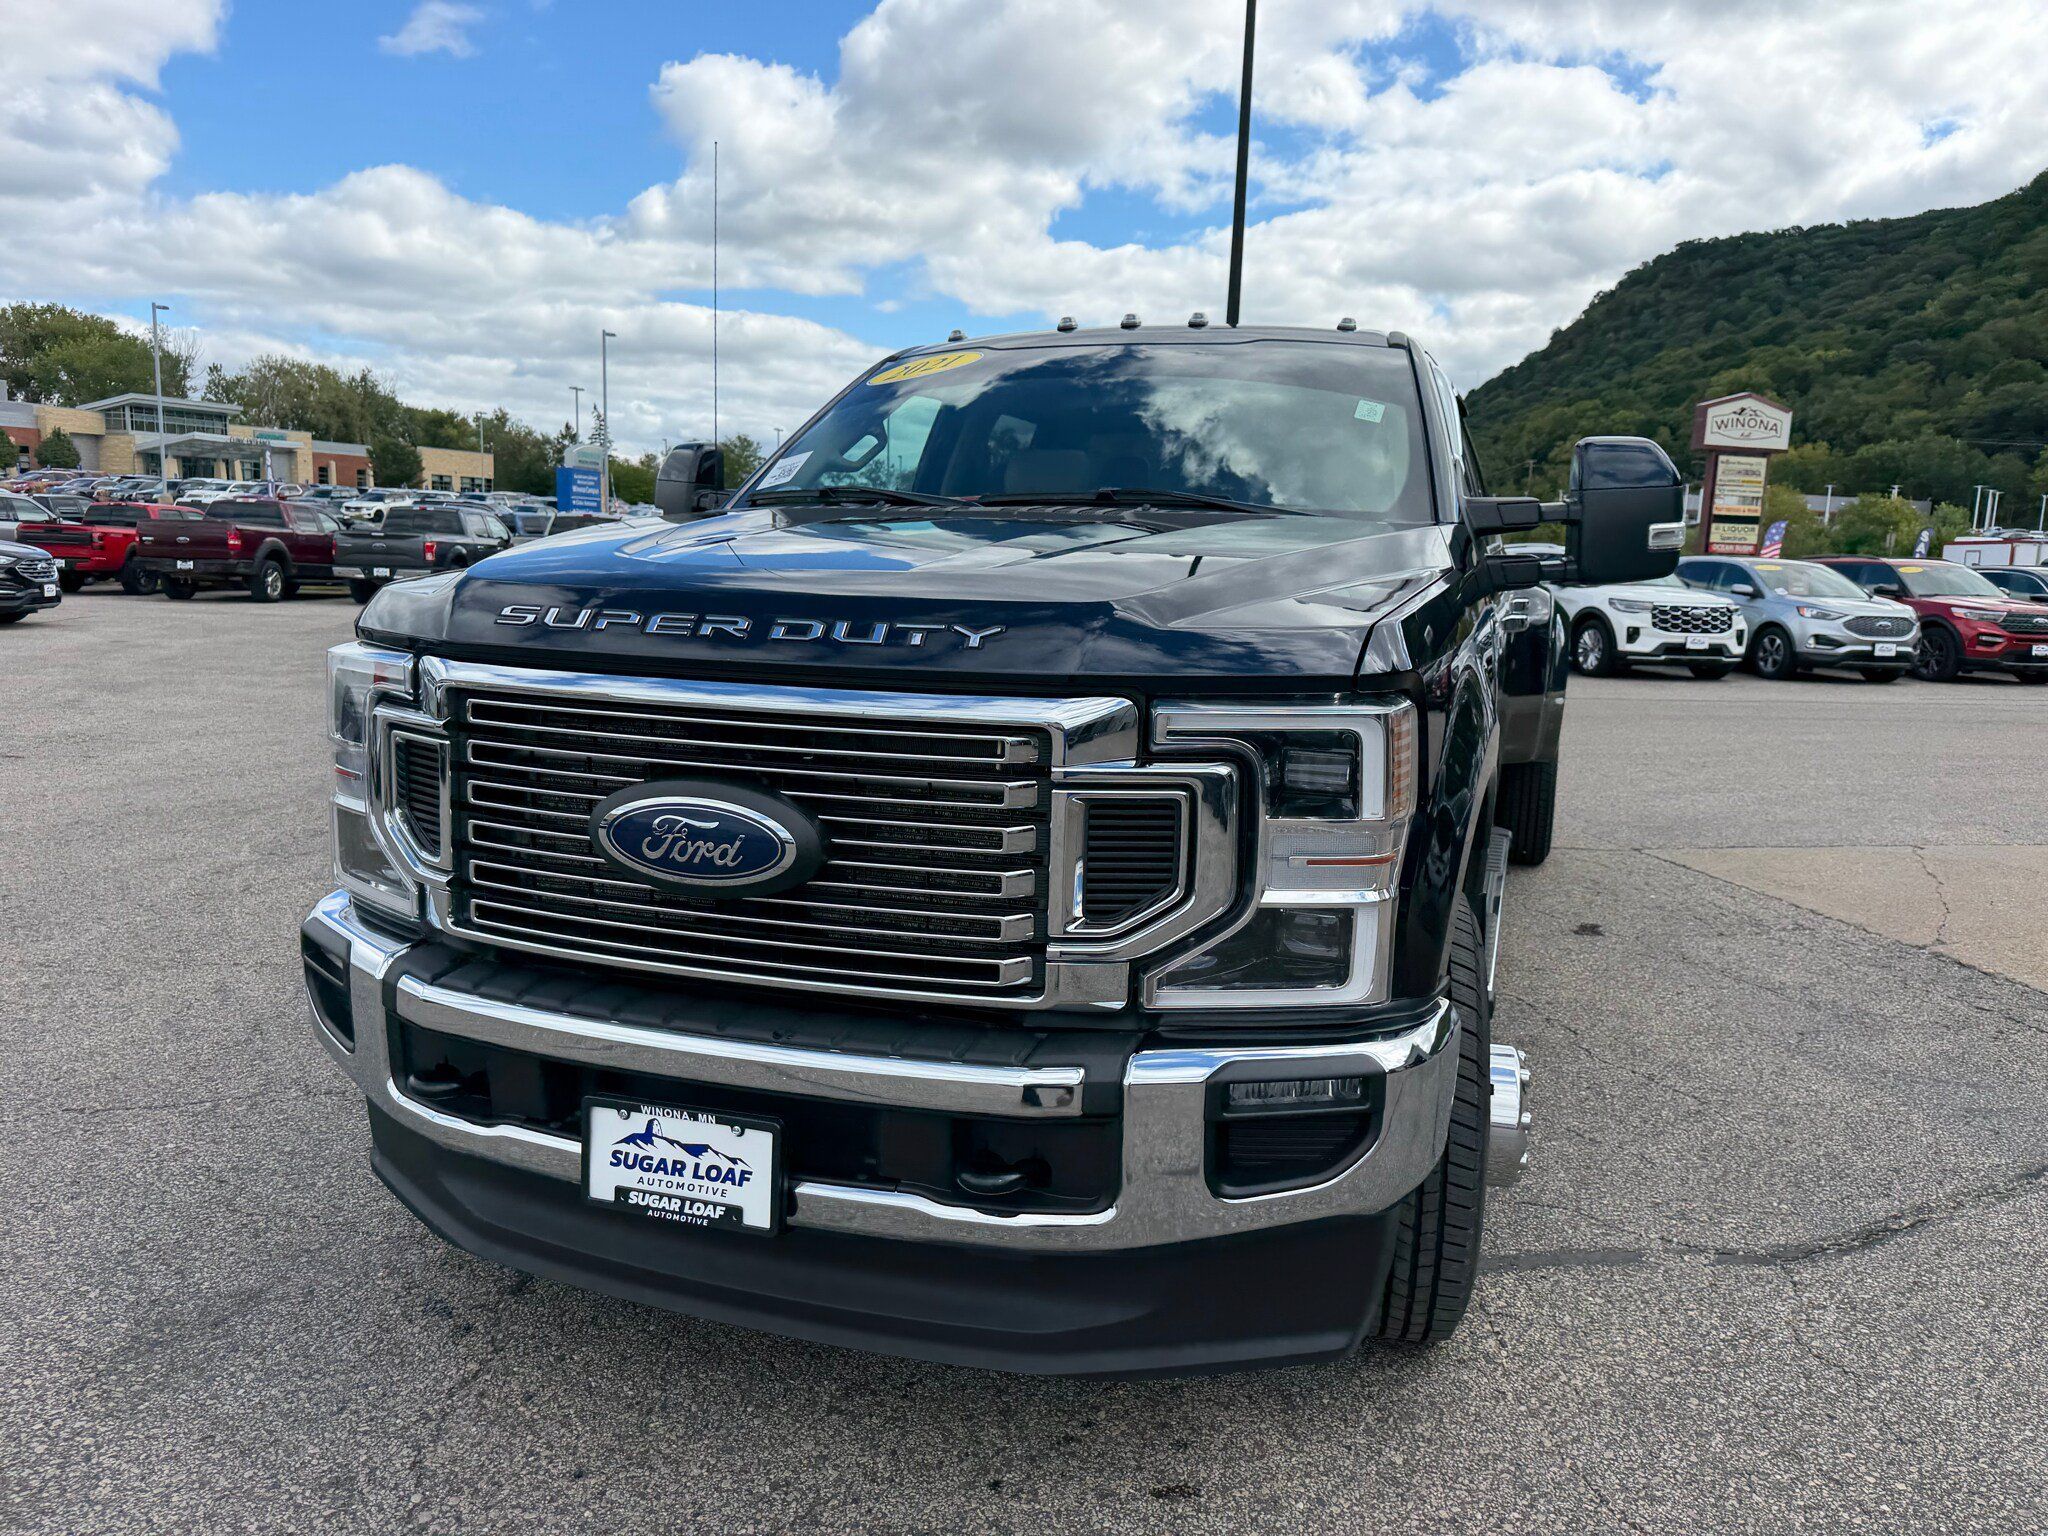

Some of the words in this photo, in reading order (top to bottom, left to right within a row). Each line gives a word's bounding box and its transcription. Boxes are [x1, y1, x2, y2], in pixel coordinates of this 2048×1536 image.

[882, 354, 965, 381] 2021
[1715, 418, 1779, 435] WINONA
[495, 605, 752, 639] SUPER
[769, 618, 1007, 649] DUTY
[641, 814, 746, 867] Ford
[640, 1104, 694, 1121] WINONA,
[698, 1113, 716, 1124] MN
[609, 1149, 687, 1178] SUGAR
[692, 1164, 754, 1188] LOAF
[636, 1176, 728, 1199] AUTOMOTIVE
[628, 1190, 681, 1212] SUGAR
[683, 1200, 726, 1219] LOAF
[647, 1209, 709, 1226] AUTOMOTIVE
